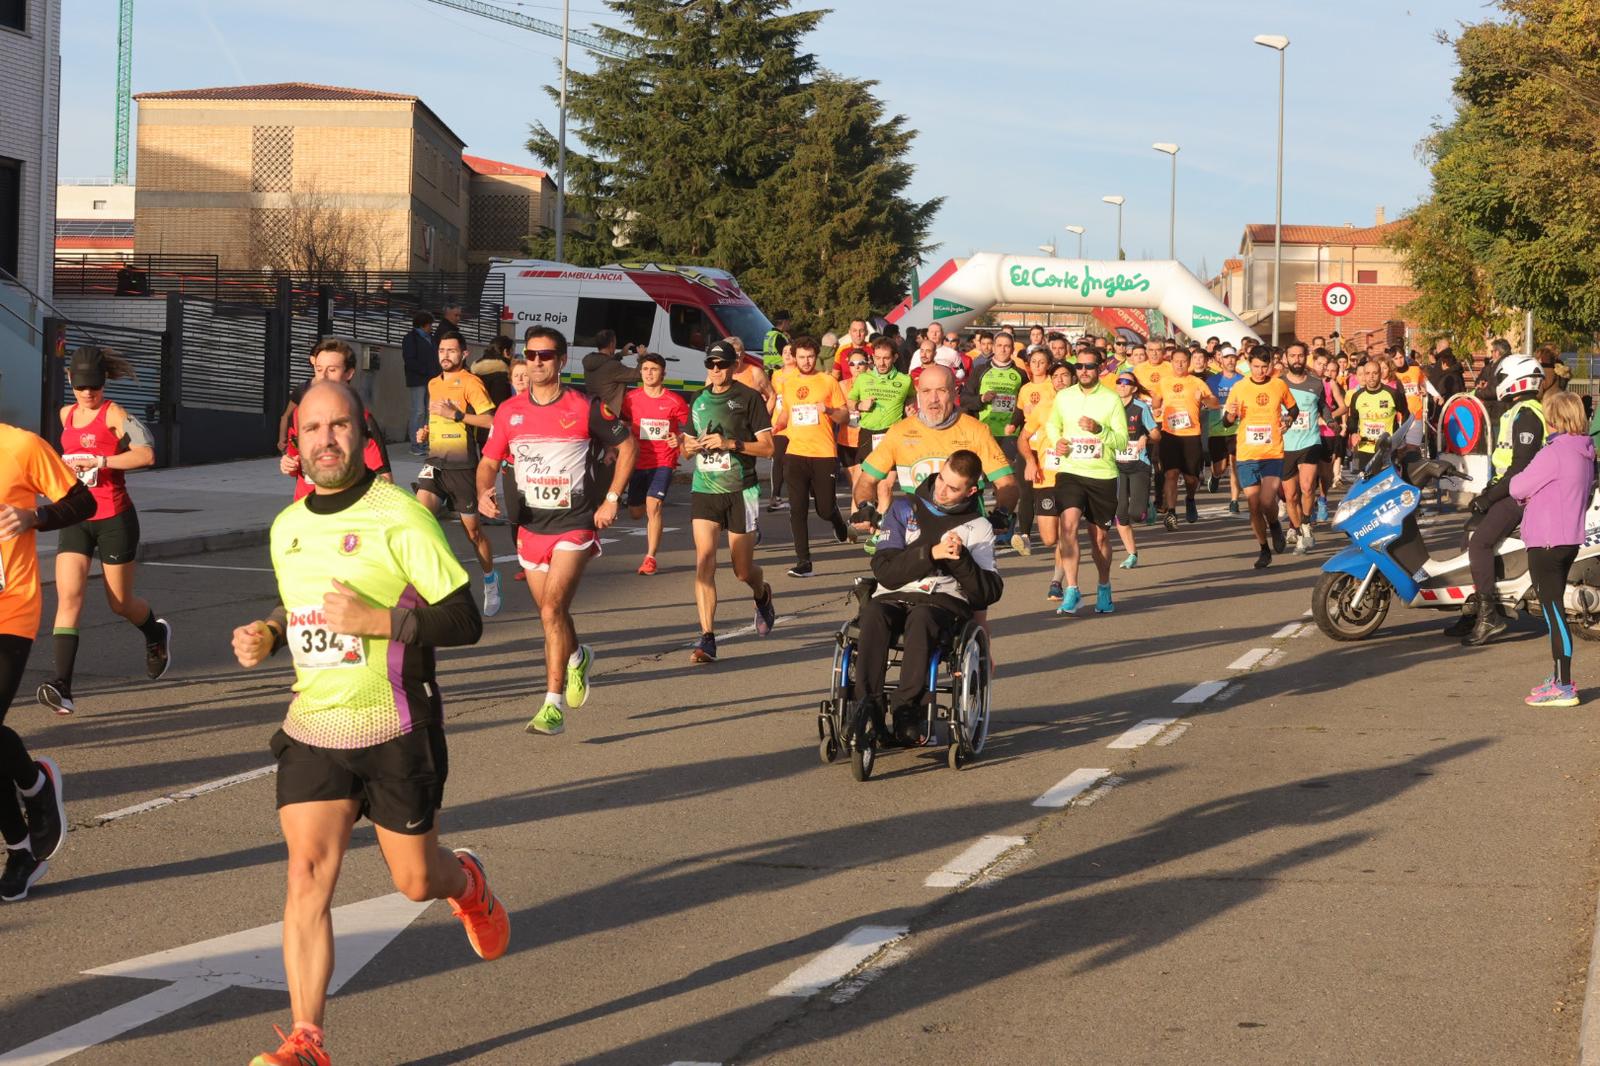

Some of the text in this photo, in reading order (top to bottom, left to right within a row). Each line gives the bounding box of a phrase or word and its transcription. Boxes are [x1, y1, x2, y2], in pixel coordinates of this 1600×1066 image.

[560, 271, 622, 281] AMBULANCIA
[1010, 265, 1150, 297] El Corte Inglés
[1330, 294, 1347, 304] 30
[517, 312, 568, 324] Cruz Roja
[997, 400, 1011, 408] 352
[649, 427, 661, 435] 98
[1253, 432, 1264, 441] 25
[1076, 444, 1095, 454] 399
[703, 453, 723, 465] 254
[534, 486, 561, 501] 169
[1372, 499, 1396, 517] 112
[290, 610, 328, 627] bedu
[301, 628, 345, 653] 334
